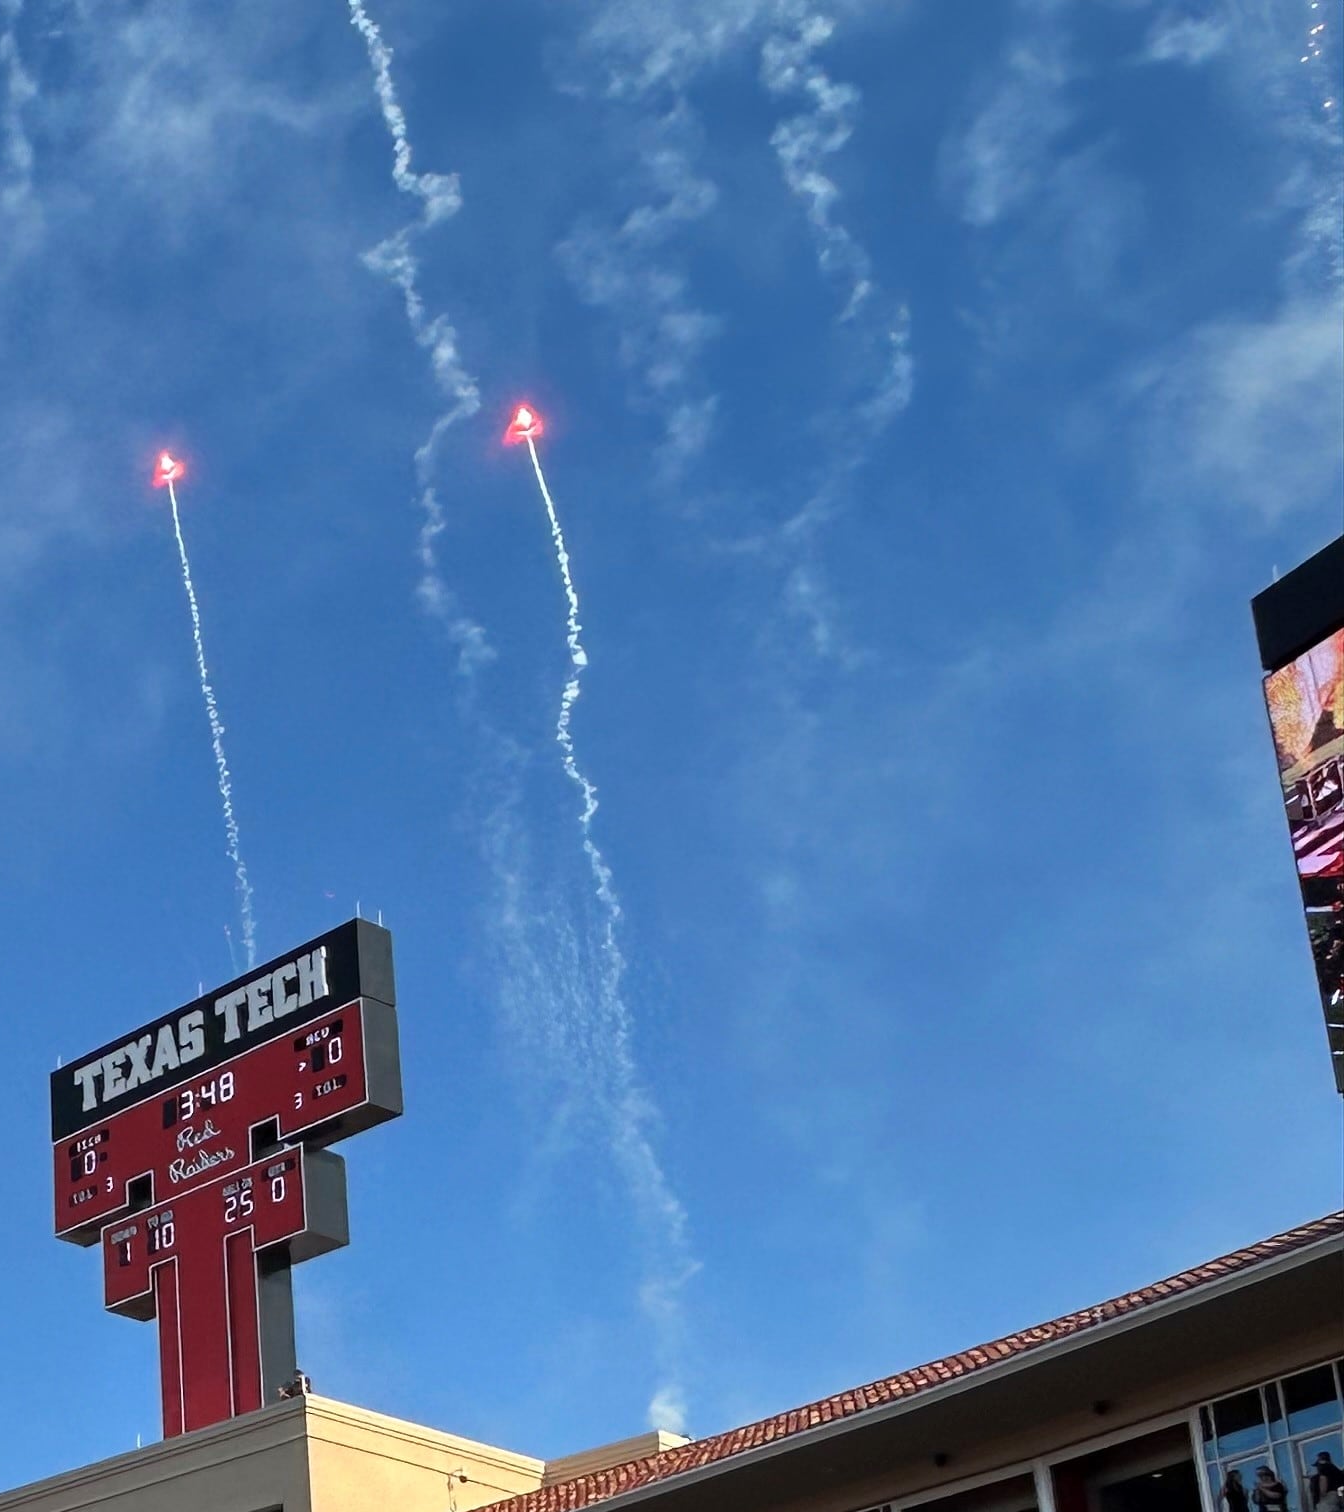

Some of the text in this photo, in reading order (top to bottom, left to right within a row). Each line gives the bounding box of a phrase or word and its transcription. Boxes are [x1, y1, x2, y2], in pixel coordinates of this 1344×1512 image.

[74, 945, 330, 1112] TEXAS TECH
[328, 1036, 342, 1064] 0
[179, 1072, 234, 1122] 3:48
[293, 1091, 303, 1110] 3
[176, 1119, 222, 1152] Red
[84, 1150, 96, 1175] 0
[169, 1147, 235, 1184] Raiders
[106, 1176, 114, 1193] 3
[271, 1176, 285, 1203] 0
[224, 1189, 254, 1223] 25
[154, 1222, 174, 1250] 10
